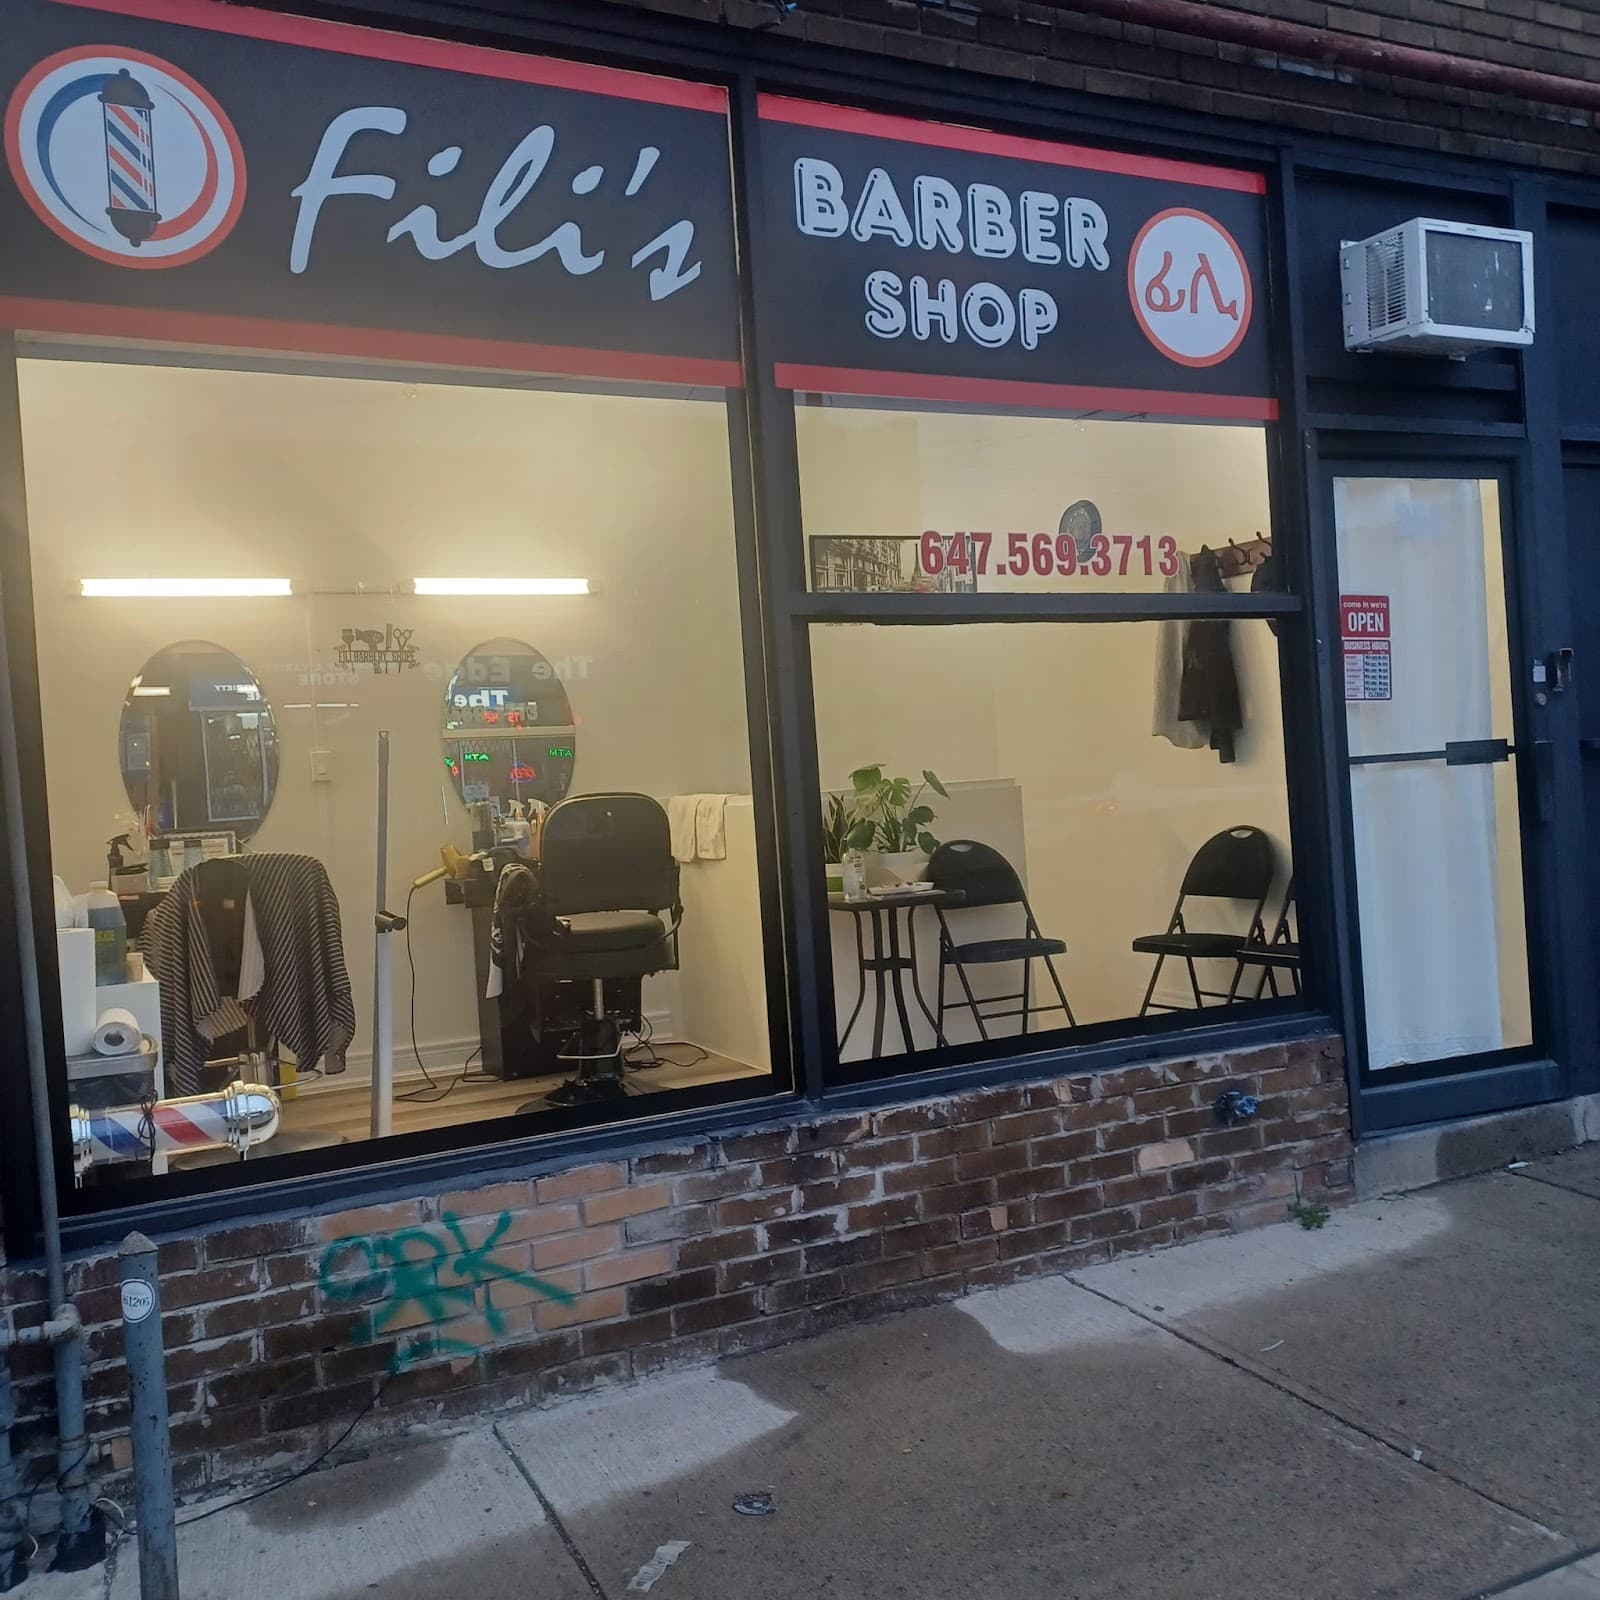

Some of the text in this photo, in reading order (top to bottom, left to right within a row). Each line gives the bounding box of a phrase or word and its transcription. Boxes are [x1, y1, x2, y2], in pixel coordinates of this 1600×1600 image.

[291, 107, 701, 300] Fili's
[793, 157, 1111, 271] BARBER
[864, 270, 1059, 351] SHOP
[919, 530, 1180, 577] 647.569.3713
[1348, 612, 1384, 632] OPEN
